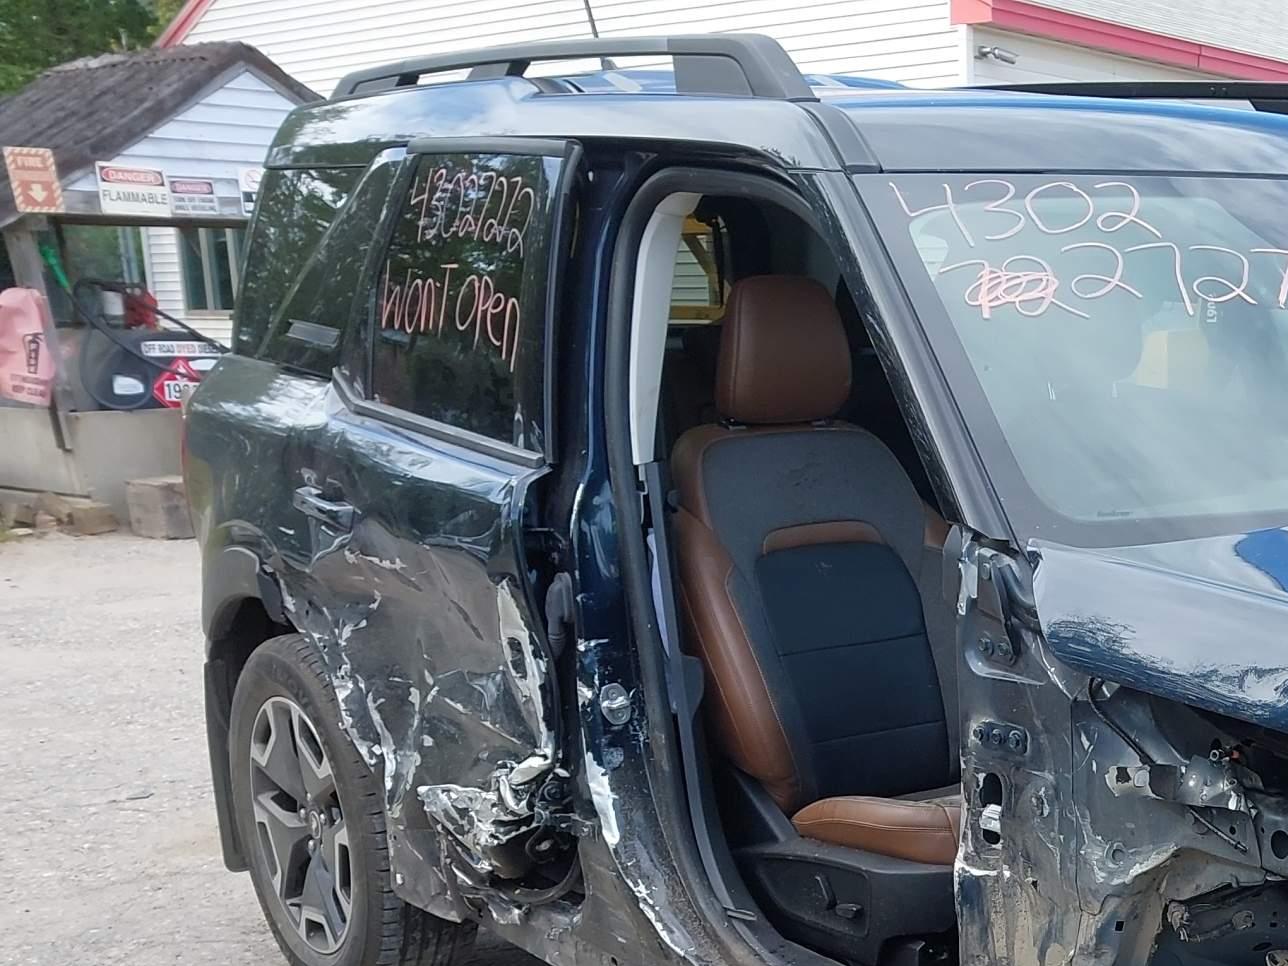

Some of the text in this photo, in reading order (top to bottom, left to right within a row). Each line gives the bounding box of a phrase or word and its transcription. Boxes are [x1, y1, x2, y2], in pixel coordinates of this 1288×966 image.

[108, 170, 156, 184] DANGER
[102, 190, 168, 205] FLAMMABLE
[888, 179, 1162, 248] 4302
